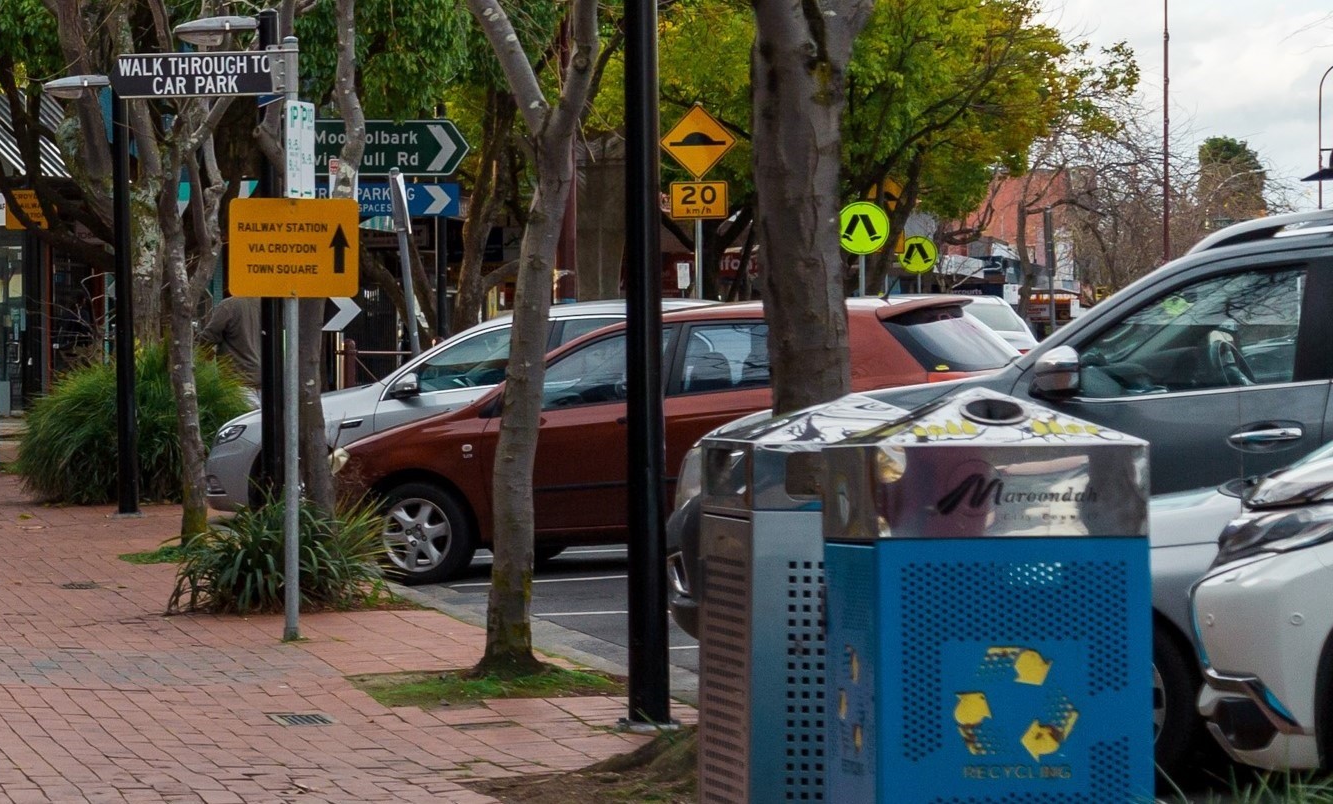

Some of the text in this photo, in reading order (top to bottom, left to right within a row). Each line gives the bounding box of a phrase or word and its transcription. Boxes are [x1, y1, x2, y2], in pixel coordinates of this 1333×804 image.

[118, 55, 271, 76] WALK THROUGH TO
[152, 75, 239, 95] CAR PARK
[315, 130, 419, 145] Mooolbark
[397, 152, 419, 166] Rd
[358, 188, 416, 200] PARKG
[680, 185, 717, 205] 20
[359, 204, 393, 213] SPACES
[686, 206, 712, 214] km/h
[237, 222, 328, 232] RAILWAY STATION
[248, 243, 317, 253] VIA CROYDON
[246, 264, 318, 275] TOWN SQUARE
[937, 473, 1098, 515] Maroondah
[962, 766, 1072, 779] RECYCLING
